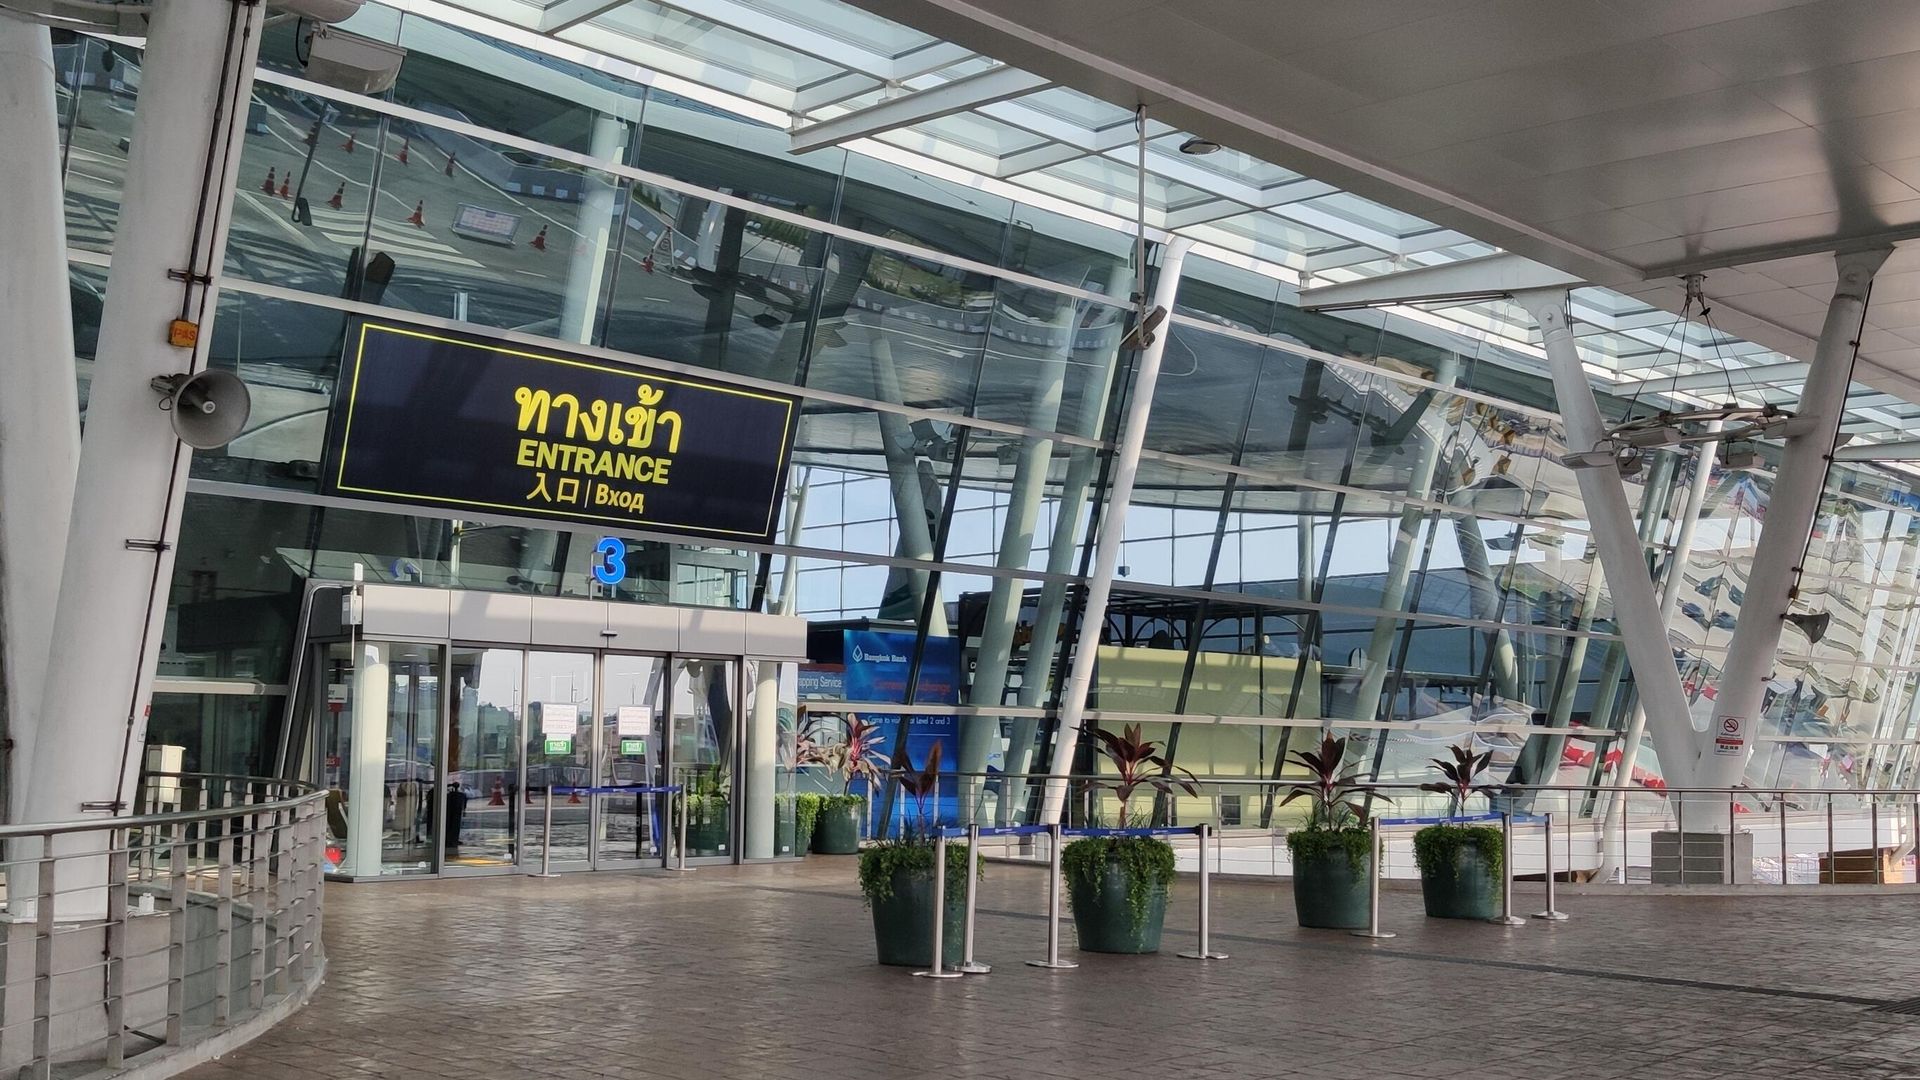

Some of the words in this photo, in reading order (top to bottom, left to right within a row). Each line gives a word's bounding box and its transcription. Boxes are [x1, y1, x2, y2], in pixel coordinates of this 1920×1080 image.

[514, 384, 682, 454] ทางเข้า
[516, 438, 672, 485] ENTRANCE
[526, 472, 580, 504] 入口
[595, 483, 645, 514] Вход
[595, 537, 626, 584] 3
[863, 653, 891, 663] Bangkok
[891, 654, 908, 663] Bank
[820, 676, 842, 688] Service
[929, 716, 934, 725] 2
